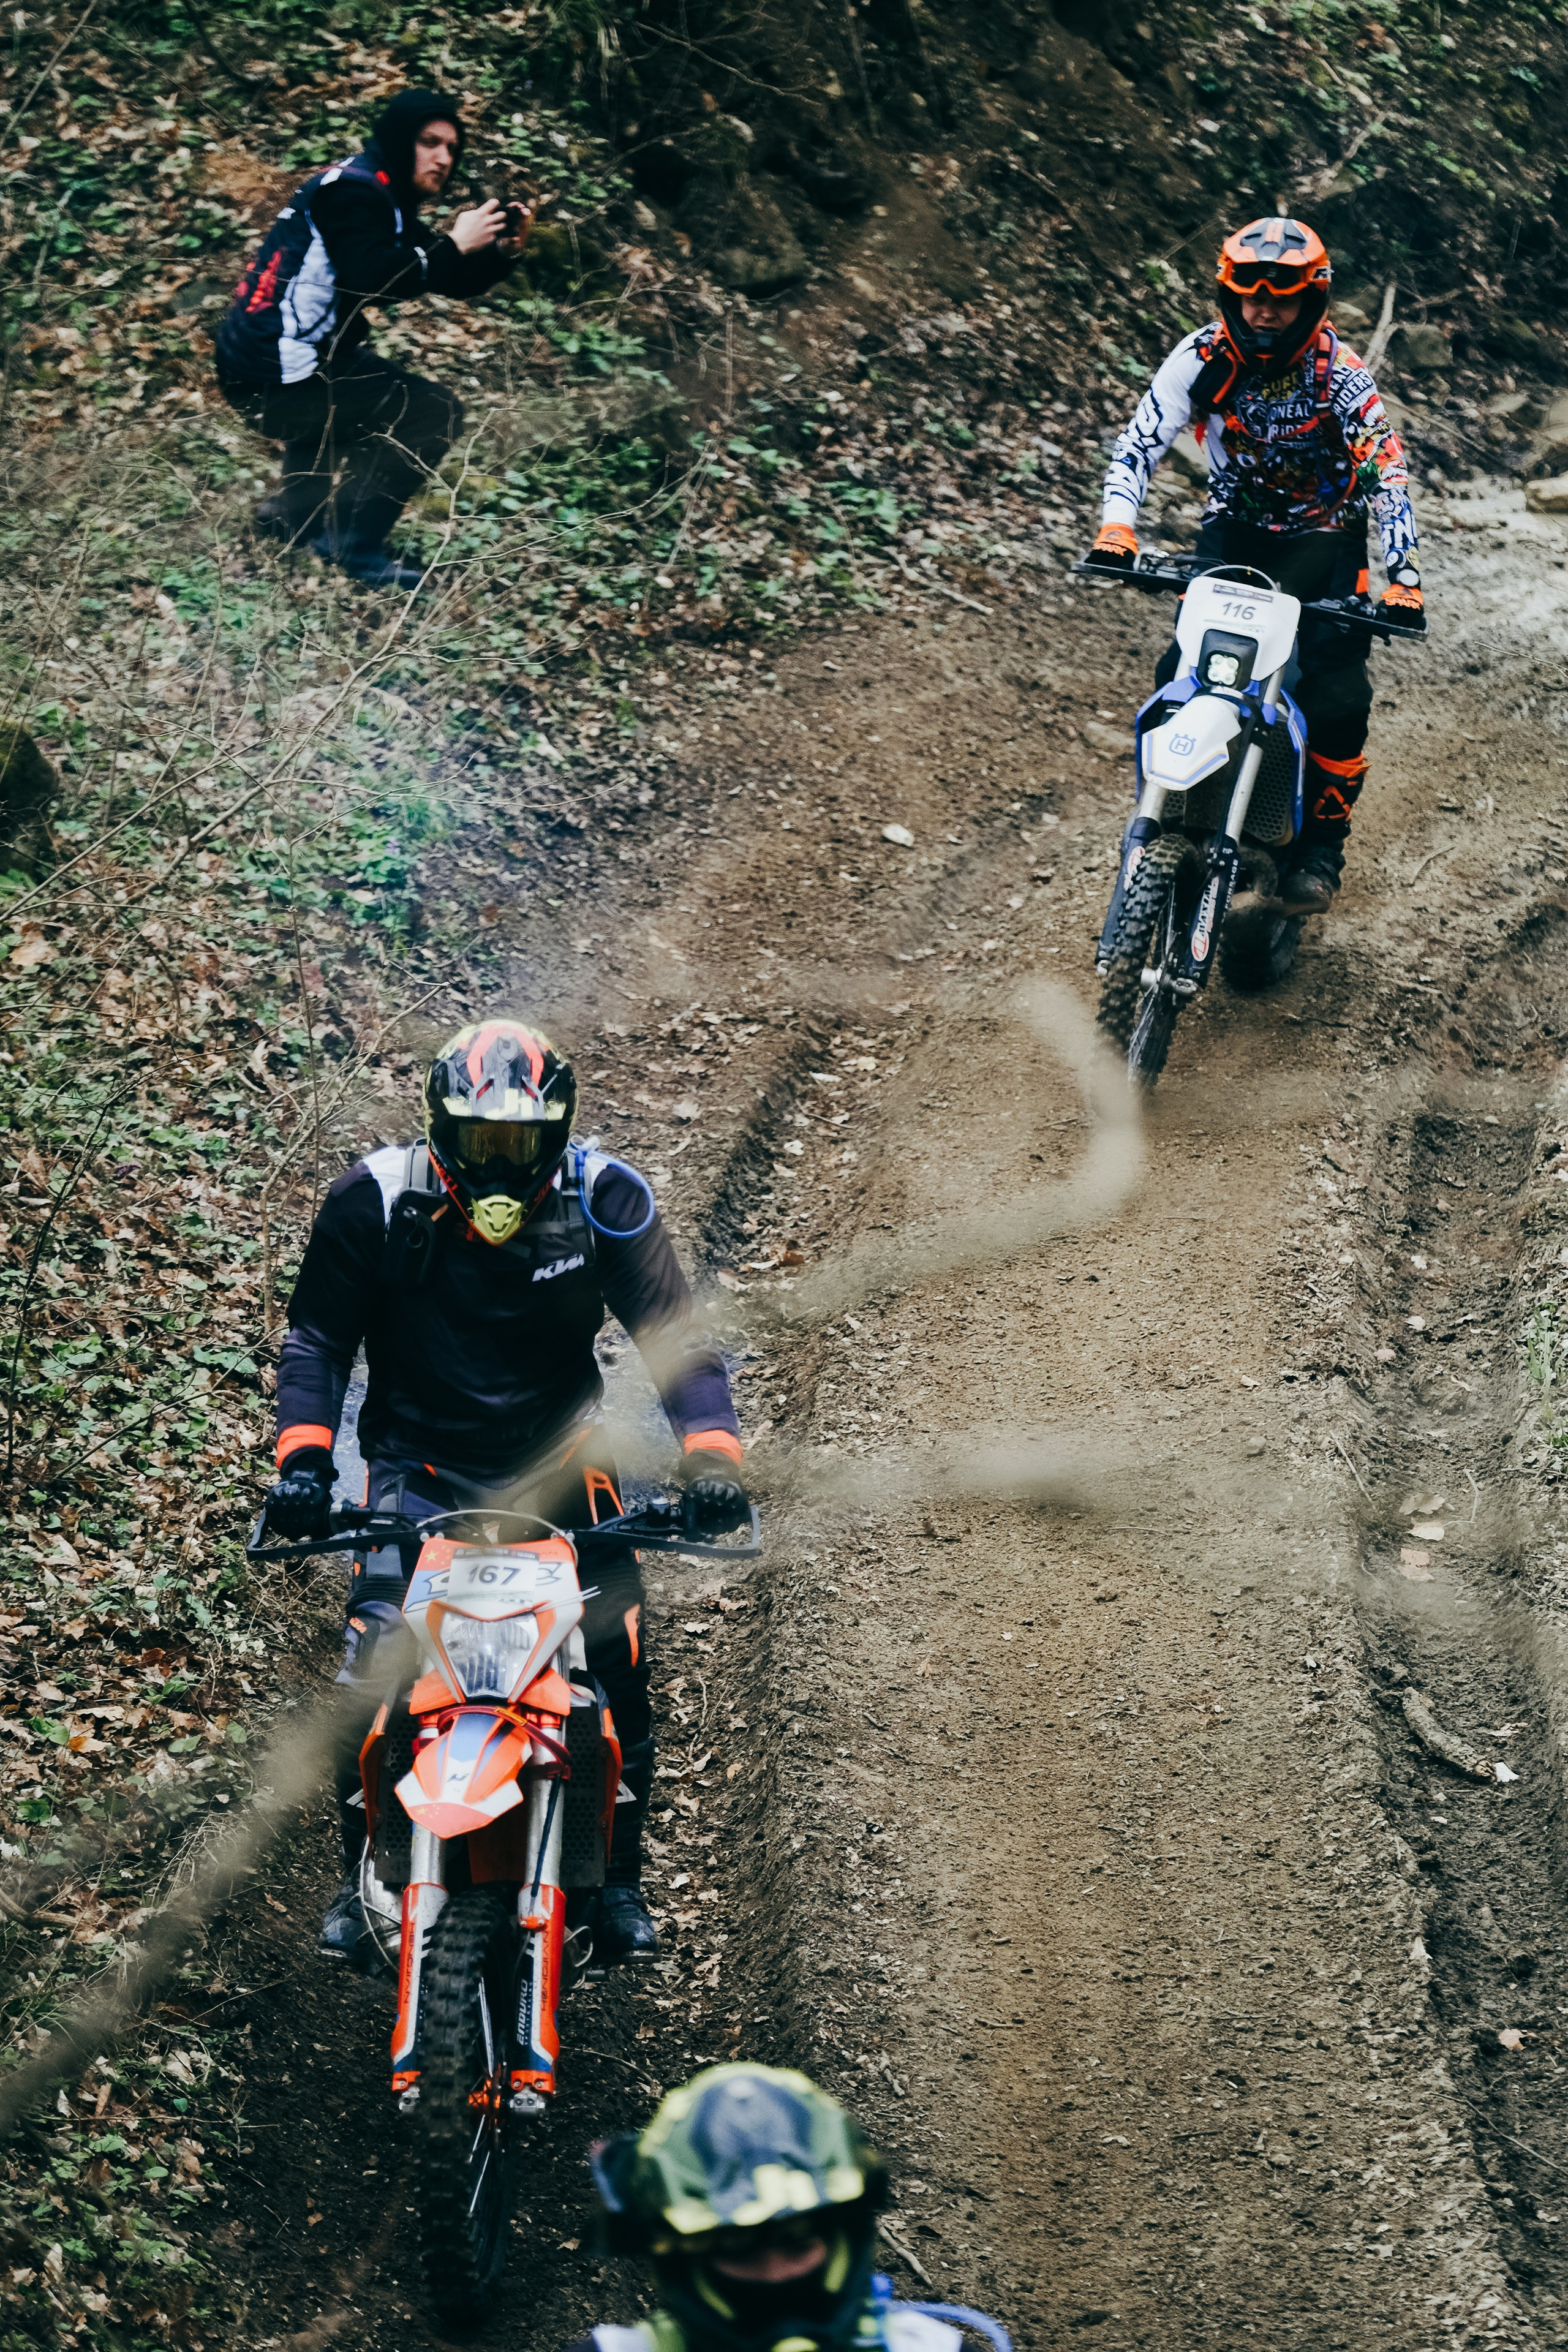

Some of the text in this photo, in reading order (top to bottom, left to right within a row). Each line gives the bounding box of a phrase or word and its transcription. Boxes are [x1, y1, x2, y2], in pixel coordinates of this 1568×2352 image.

[1223, 602, 1256, 620] 116
[467, 1564, 522, 1586] 167
[516, 1978, 529, 2046] ENDURO
